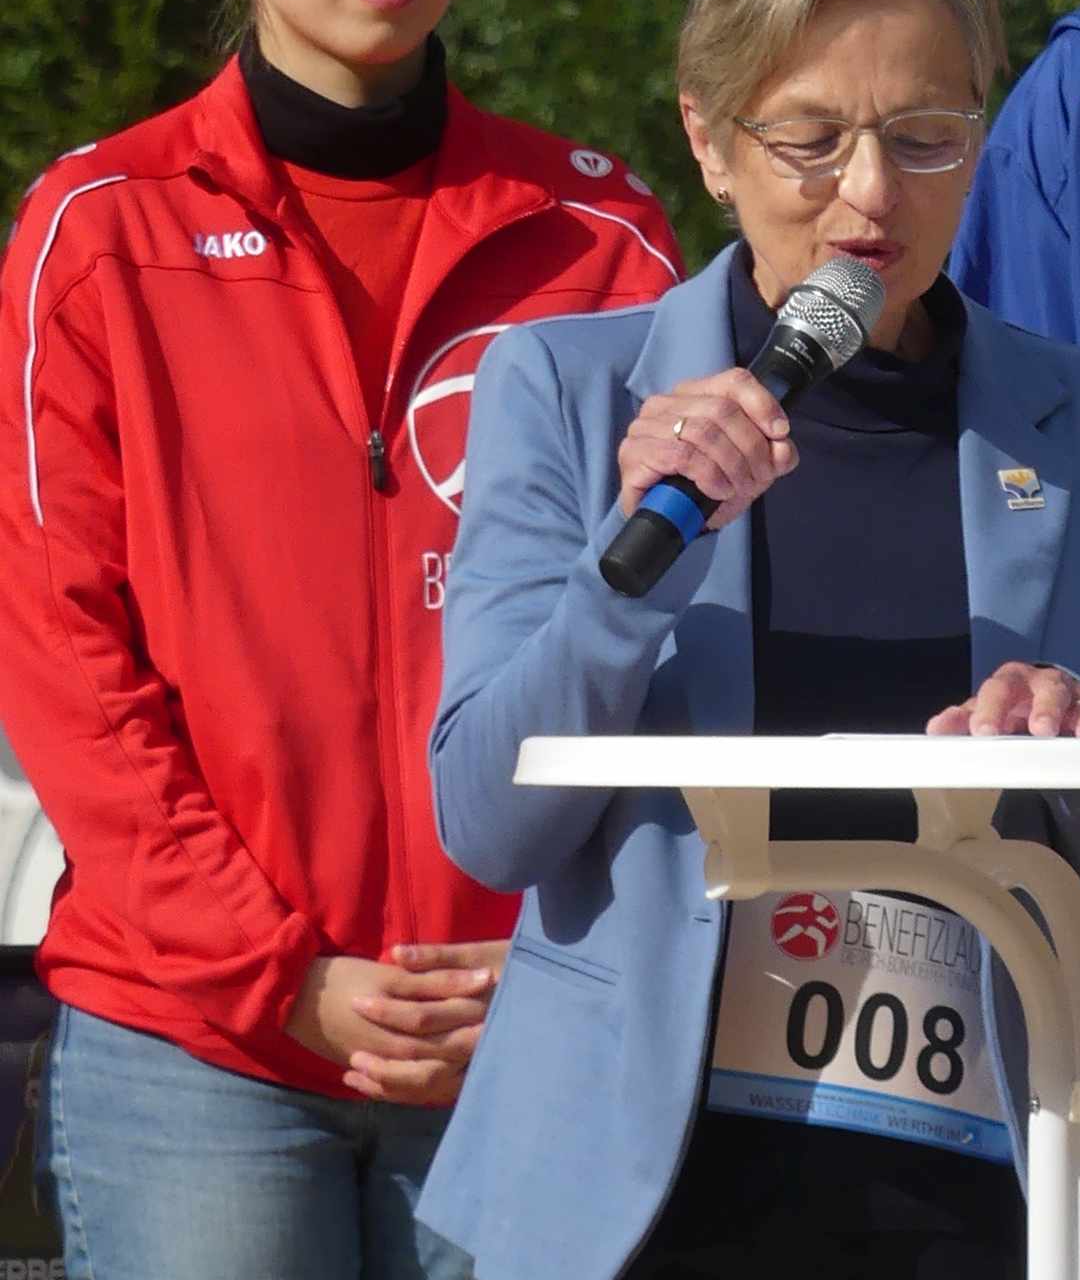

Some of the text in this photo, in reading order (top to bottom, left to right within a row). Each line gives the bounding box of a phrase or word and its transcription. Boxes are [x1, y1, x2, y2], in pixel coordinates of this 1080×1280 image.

[194, 230, 266, 258] JAKO
[421, 552, 453, 610] B
[785, 979, 966, 1095] 008
[748, 1093, 816, 1113] WASSER
[886, 1114, 962, 1141] WERTHEIM
